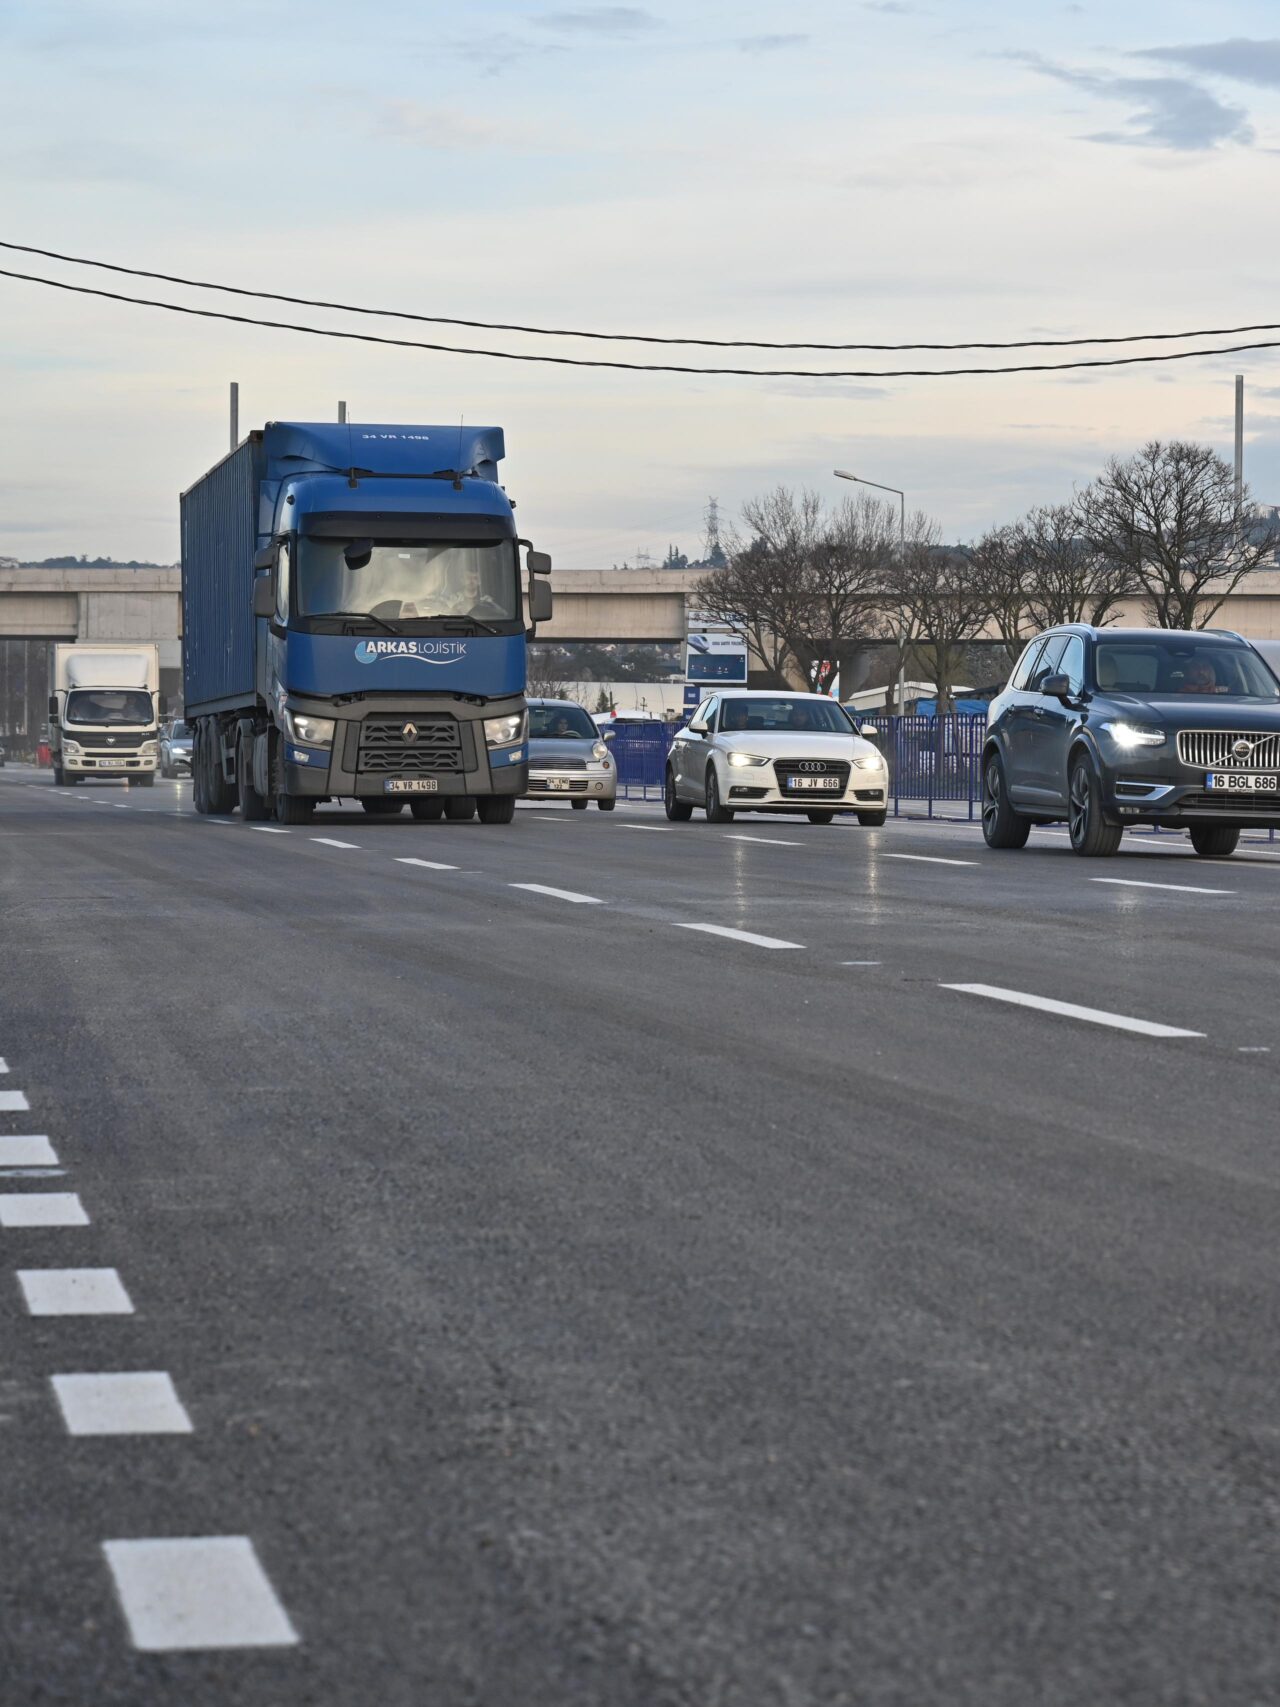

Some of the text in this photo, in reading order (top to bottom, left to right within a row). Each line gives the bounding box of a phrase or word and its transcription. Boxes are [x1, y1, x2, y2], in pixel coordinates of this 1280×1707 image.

[366, 641, 467, 654] ARKAS LOJİSTİK
[391, 780, 436, 790] 34 VR 1498
[793, 778, 838, 788] 16 JV 666
[1213, 775, 1276, 789] 16 BGL 686
